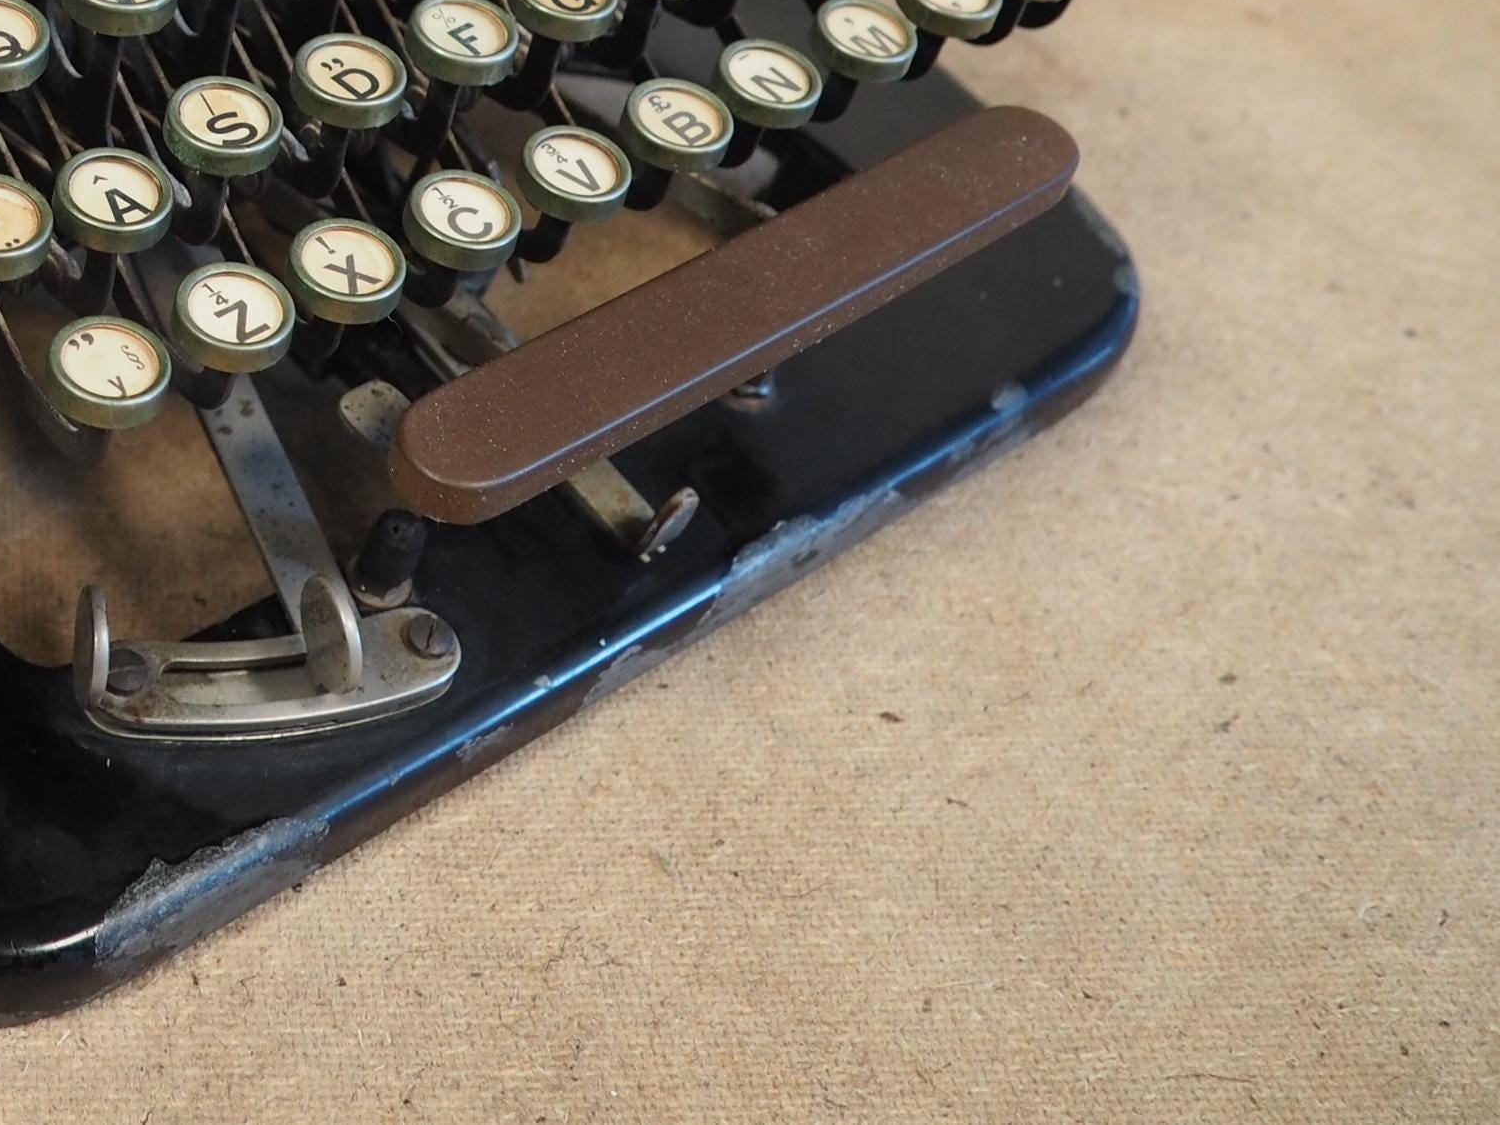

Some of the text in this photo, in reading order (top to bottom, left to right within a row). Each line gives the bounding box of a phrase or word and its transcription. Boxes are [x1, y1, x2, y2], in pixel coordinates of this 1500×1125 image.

[431, 8, 456, 27] %
[447, 22, 482, 55] F
[850, 25, 902, 59] M
[330, 68, 380, 101] D
[750, 67, 804, 103] N
[206, 111, 258, 146] S
[663, 111, 712, 146] B
[555, 159, 601, 192] V
[104, 188, 152, 225] A
[447, 207, 493, 240] C
[314, 235, 336, 254] !
[323, 254, 382, 295] X
[213, 299, 271, 343] Z
